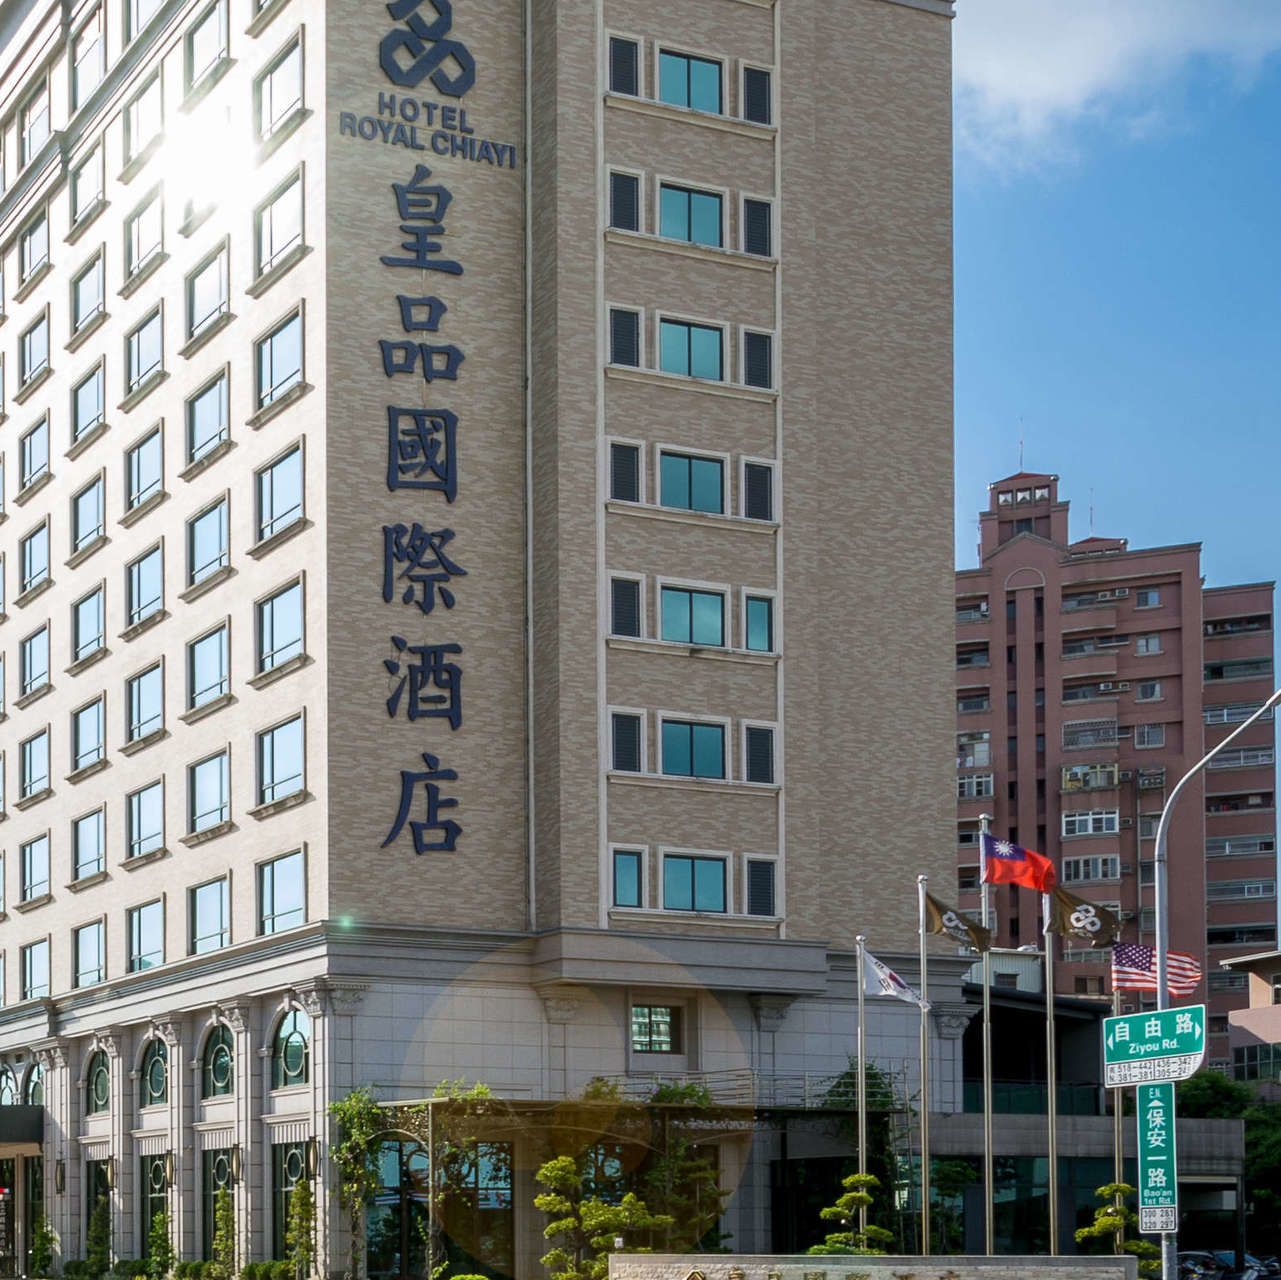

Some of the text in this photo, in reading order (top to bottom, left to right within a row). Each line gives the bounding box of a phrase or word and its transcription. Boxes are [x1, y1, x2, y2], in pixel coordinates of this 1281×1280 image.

[378, 91, 475, 134] HOTEL
[339, 111, 516, 169] ROYAL CHIAYI
[379, 164, 467, 856] 皇品國際酒店
[1115, 1013, 1194, 1042] 自由路
[1128, 1038, 1180, 1055] Ziyou Rd.
[1147, 1107, 1168, 1188] 保安一路
[1143, 1188, 1173, 1198] Bao'an
[1144, 1197, 1156, 1205] 1st
